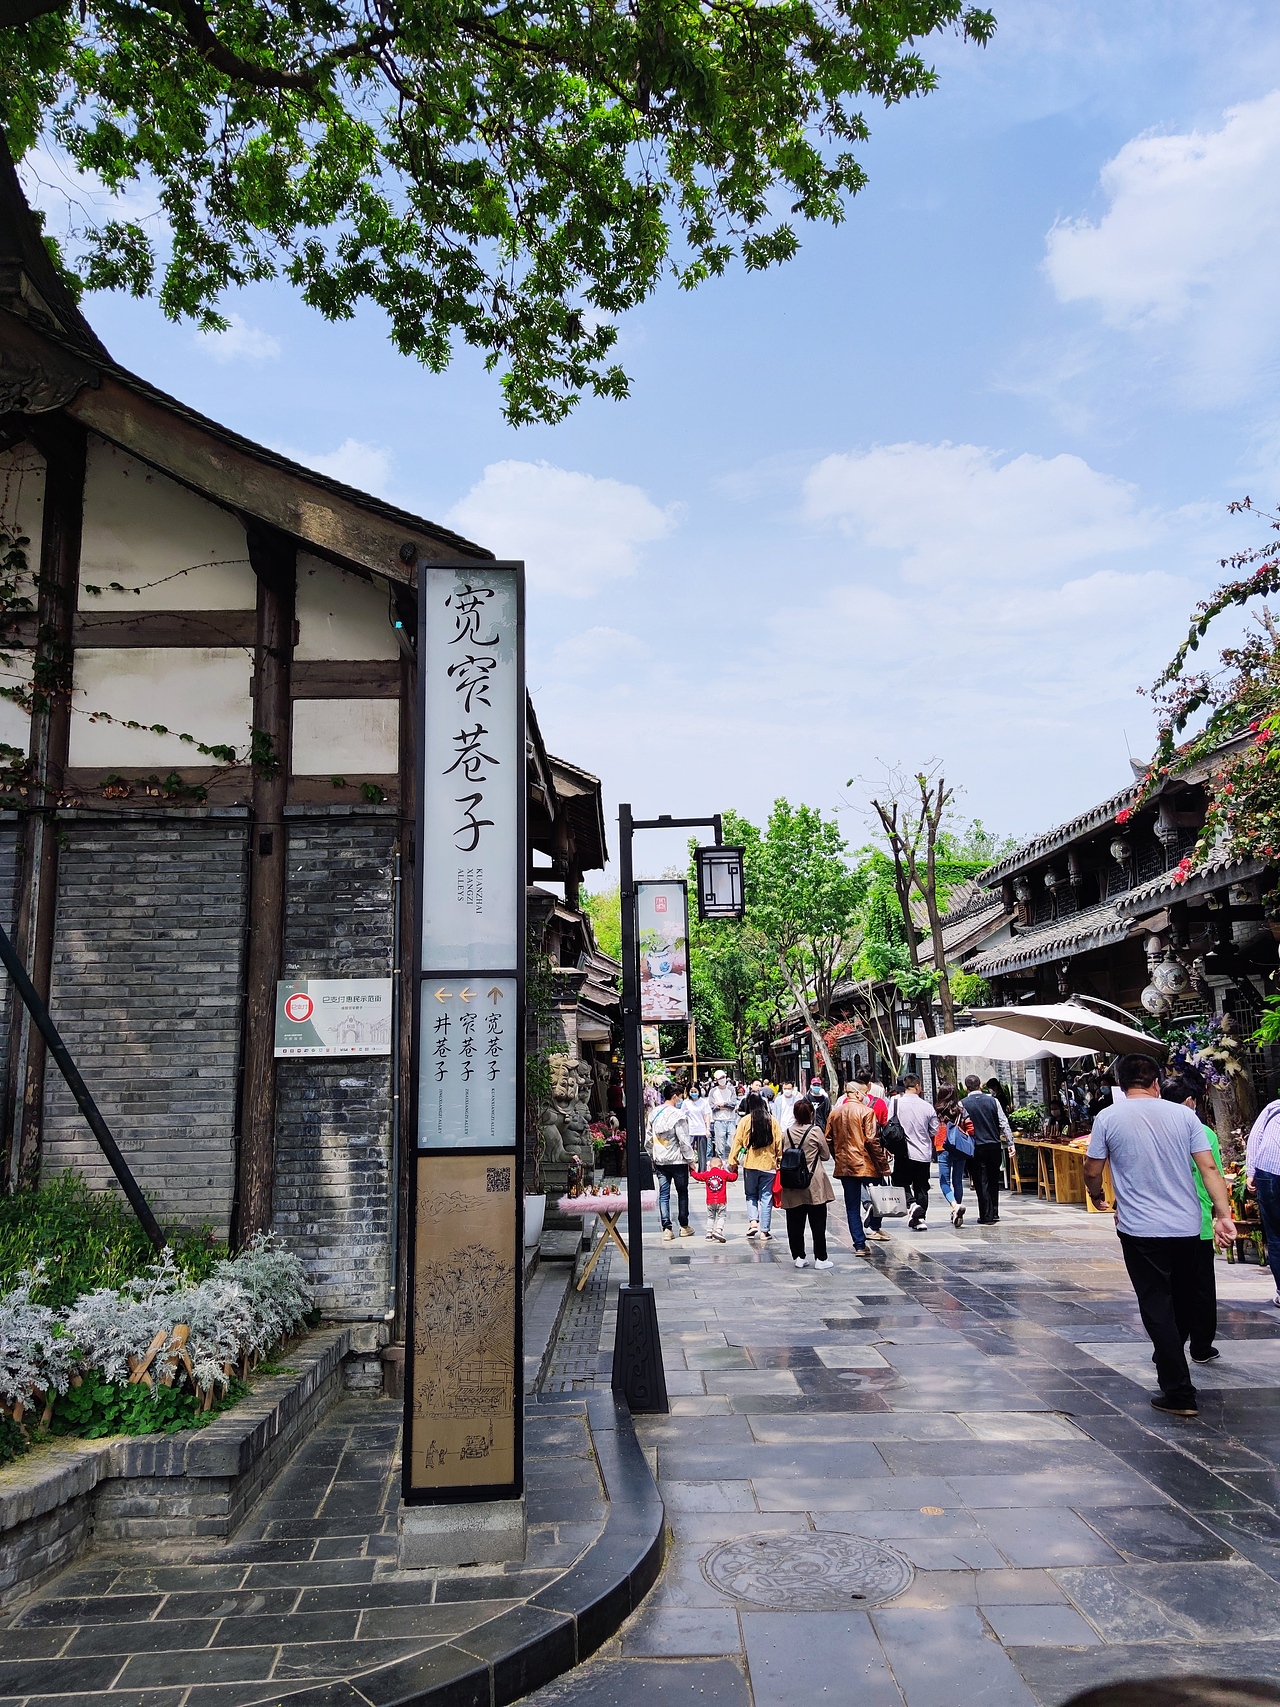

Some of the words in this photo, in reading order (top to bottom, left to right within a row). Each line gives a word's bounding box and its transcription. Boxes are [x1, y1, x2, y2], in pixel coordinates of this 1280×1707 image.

[442, 584, 500, 852] 宽窄巷子
[457, 868, 465, 902] ALLEYS
[466, 868, 474, 905] XIANGZI
[475, 868, 483, 914] KUANZHAI
[432, 1013, 451, 1081] 井巷子
[458, 1012, 477, 1081] 窄巷子
[484, 1012, 503, 1081] 宽巷子
